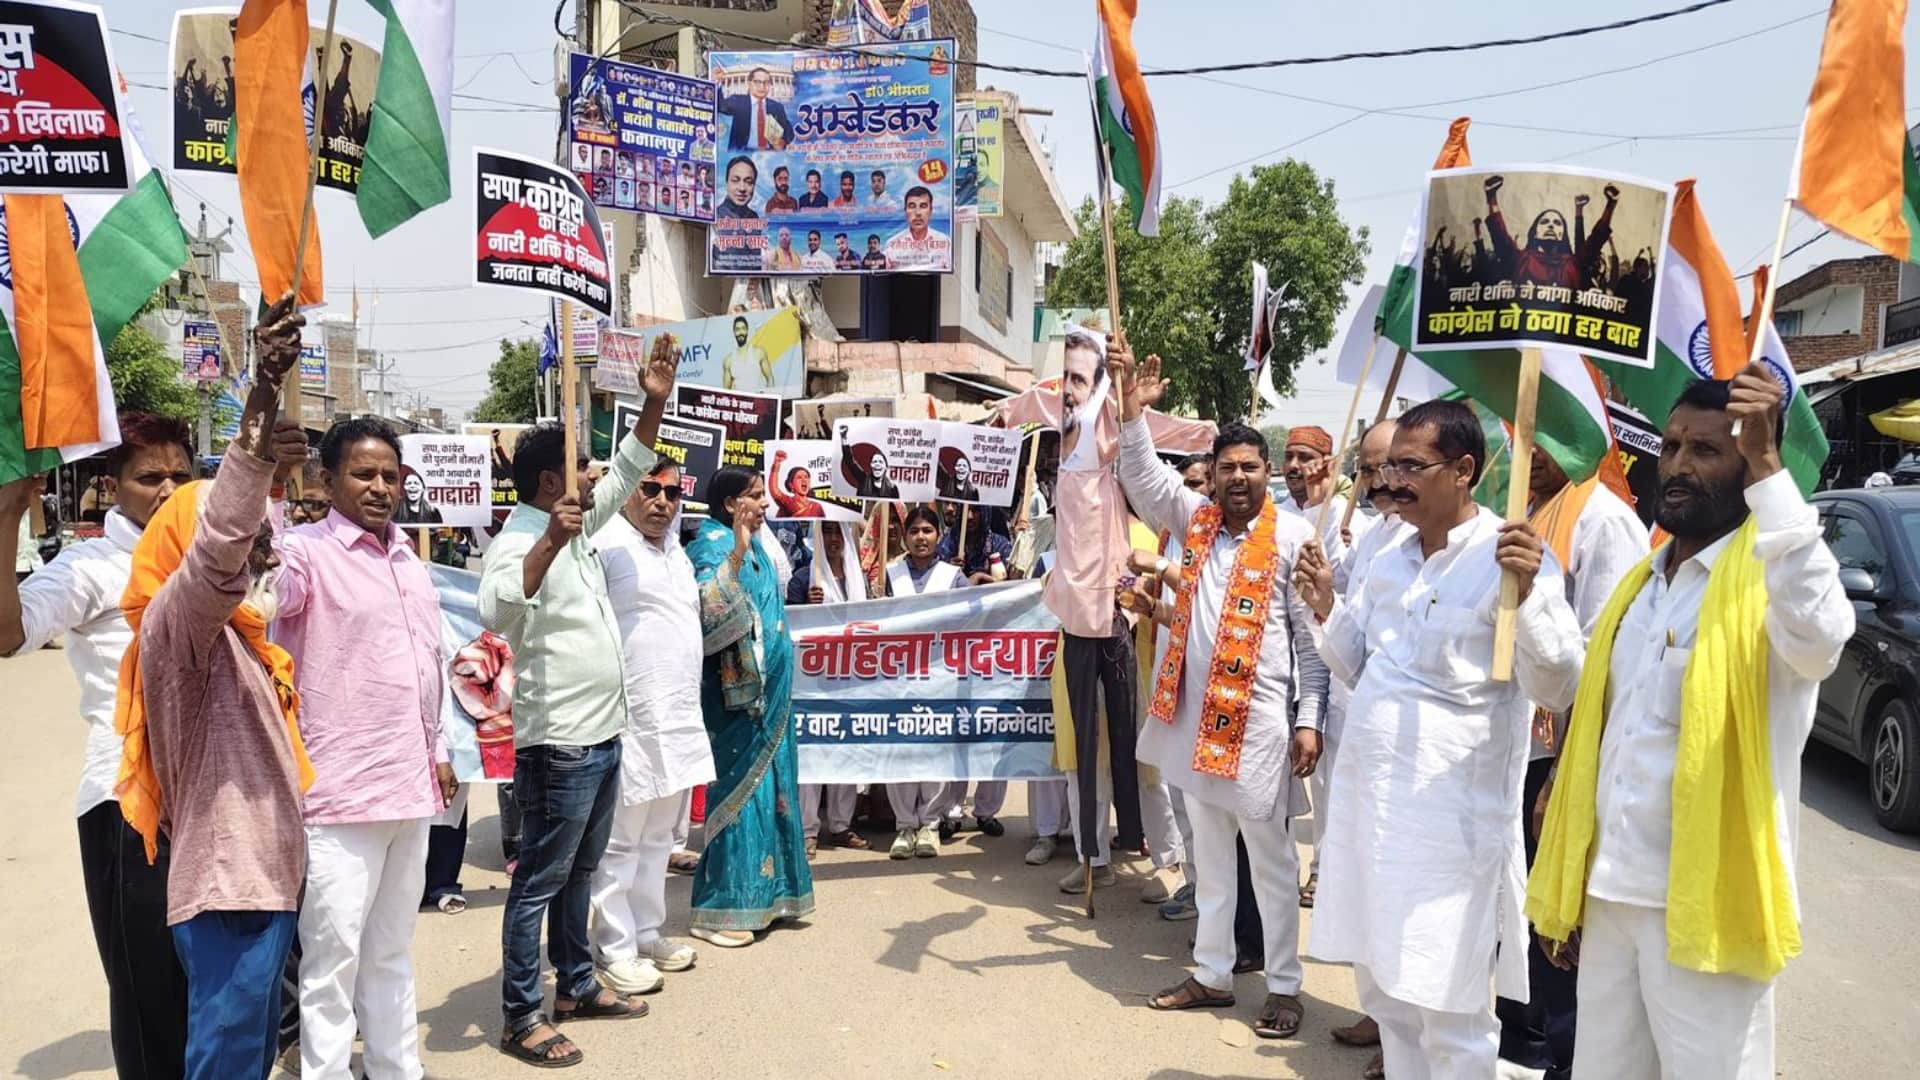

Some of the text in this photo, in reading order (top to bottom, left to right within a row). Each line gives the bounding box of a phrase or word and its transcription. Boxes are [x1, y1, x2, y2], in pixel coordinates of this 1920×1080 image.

[13, 100, 106, 135] खिलाफ
[204, 118, 230, 134] नार
[794, 92, 940, 137] अम्बेडकर
[621, 129, 687, 157] कमालपुर
[330, 157, 353, 183] हर
[537, 212, 556, 232] का
[487, 229, 526, 253] नारी
[529, 234, 562, 259] शक्ति
[563, 239, 576, 262] के
[490, 263, 534, 283] जनता
[535, 265, 564, 287] नहीं
[563, 271, 587, 294] करेगी
[1449, 280, 1627, 314] नारी शक्ति ने मांगा अधिकार
[1428, 303, 1642, 348] कांग्रेस ने ठगा हर बार
[679, 344, 712, 363] MFY
[721, 410, 733, 421] का
[1622, 428, 1662, 454] स्वाभिम
[422, 453, 432, 464] की
[434, 454, 457, 466] पुरानी
[889, 463, 930, 484] गद्दारी
[972, 469, 1009, 488] गद्दारी
[427, 481, 481, 506] गद्दारी
[799, 620, 1060, 680] महिला पदयात्र
[807, 713, 846, 740] वार,
[956, 706, 972, 736] है
[975, 706, 1055, 736] जिम्मेदार
